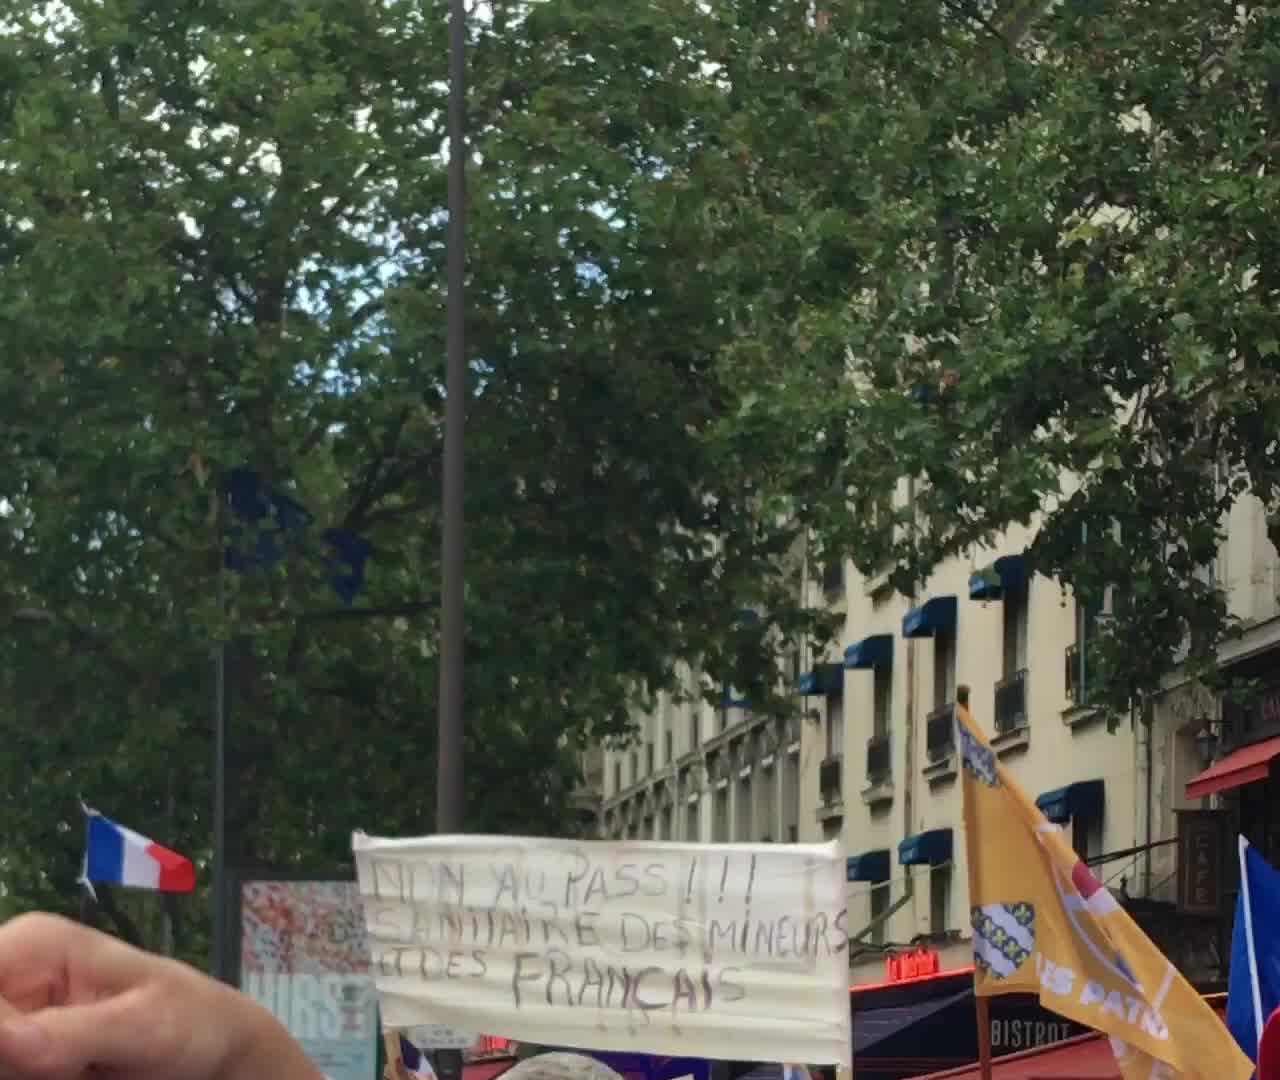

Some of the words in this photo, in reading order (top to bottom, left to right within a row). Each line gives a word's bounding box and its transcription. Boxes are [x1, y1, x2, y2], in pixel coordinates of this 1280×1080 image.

[564, 849, 667, 908] PASS
[621, 911, 690, 954] DES
[710, 908, 849, 957] MINEURS
